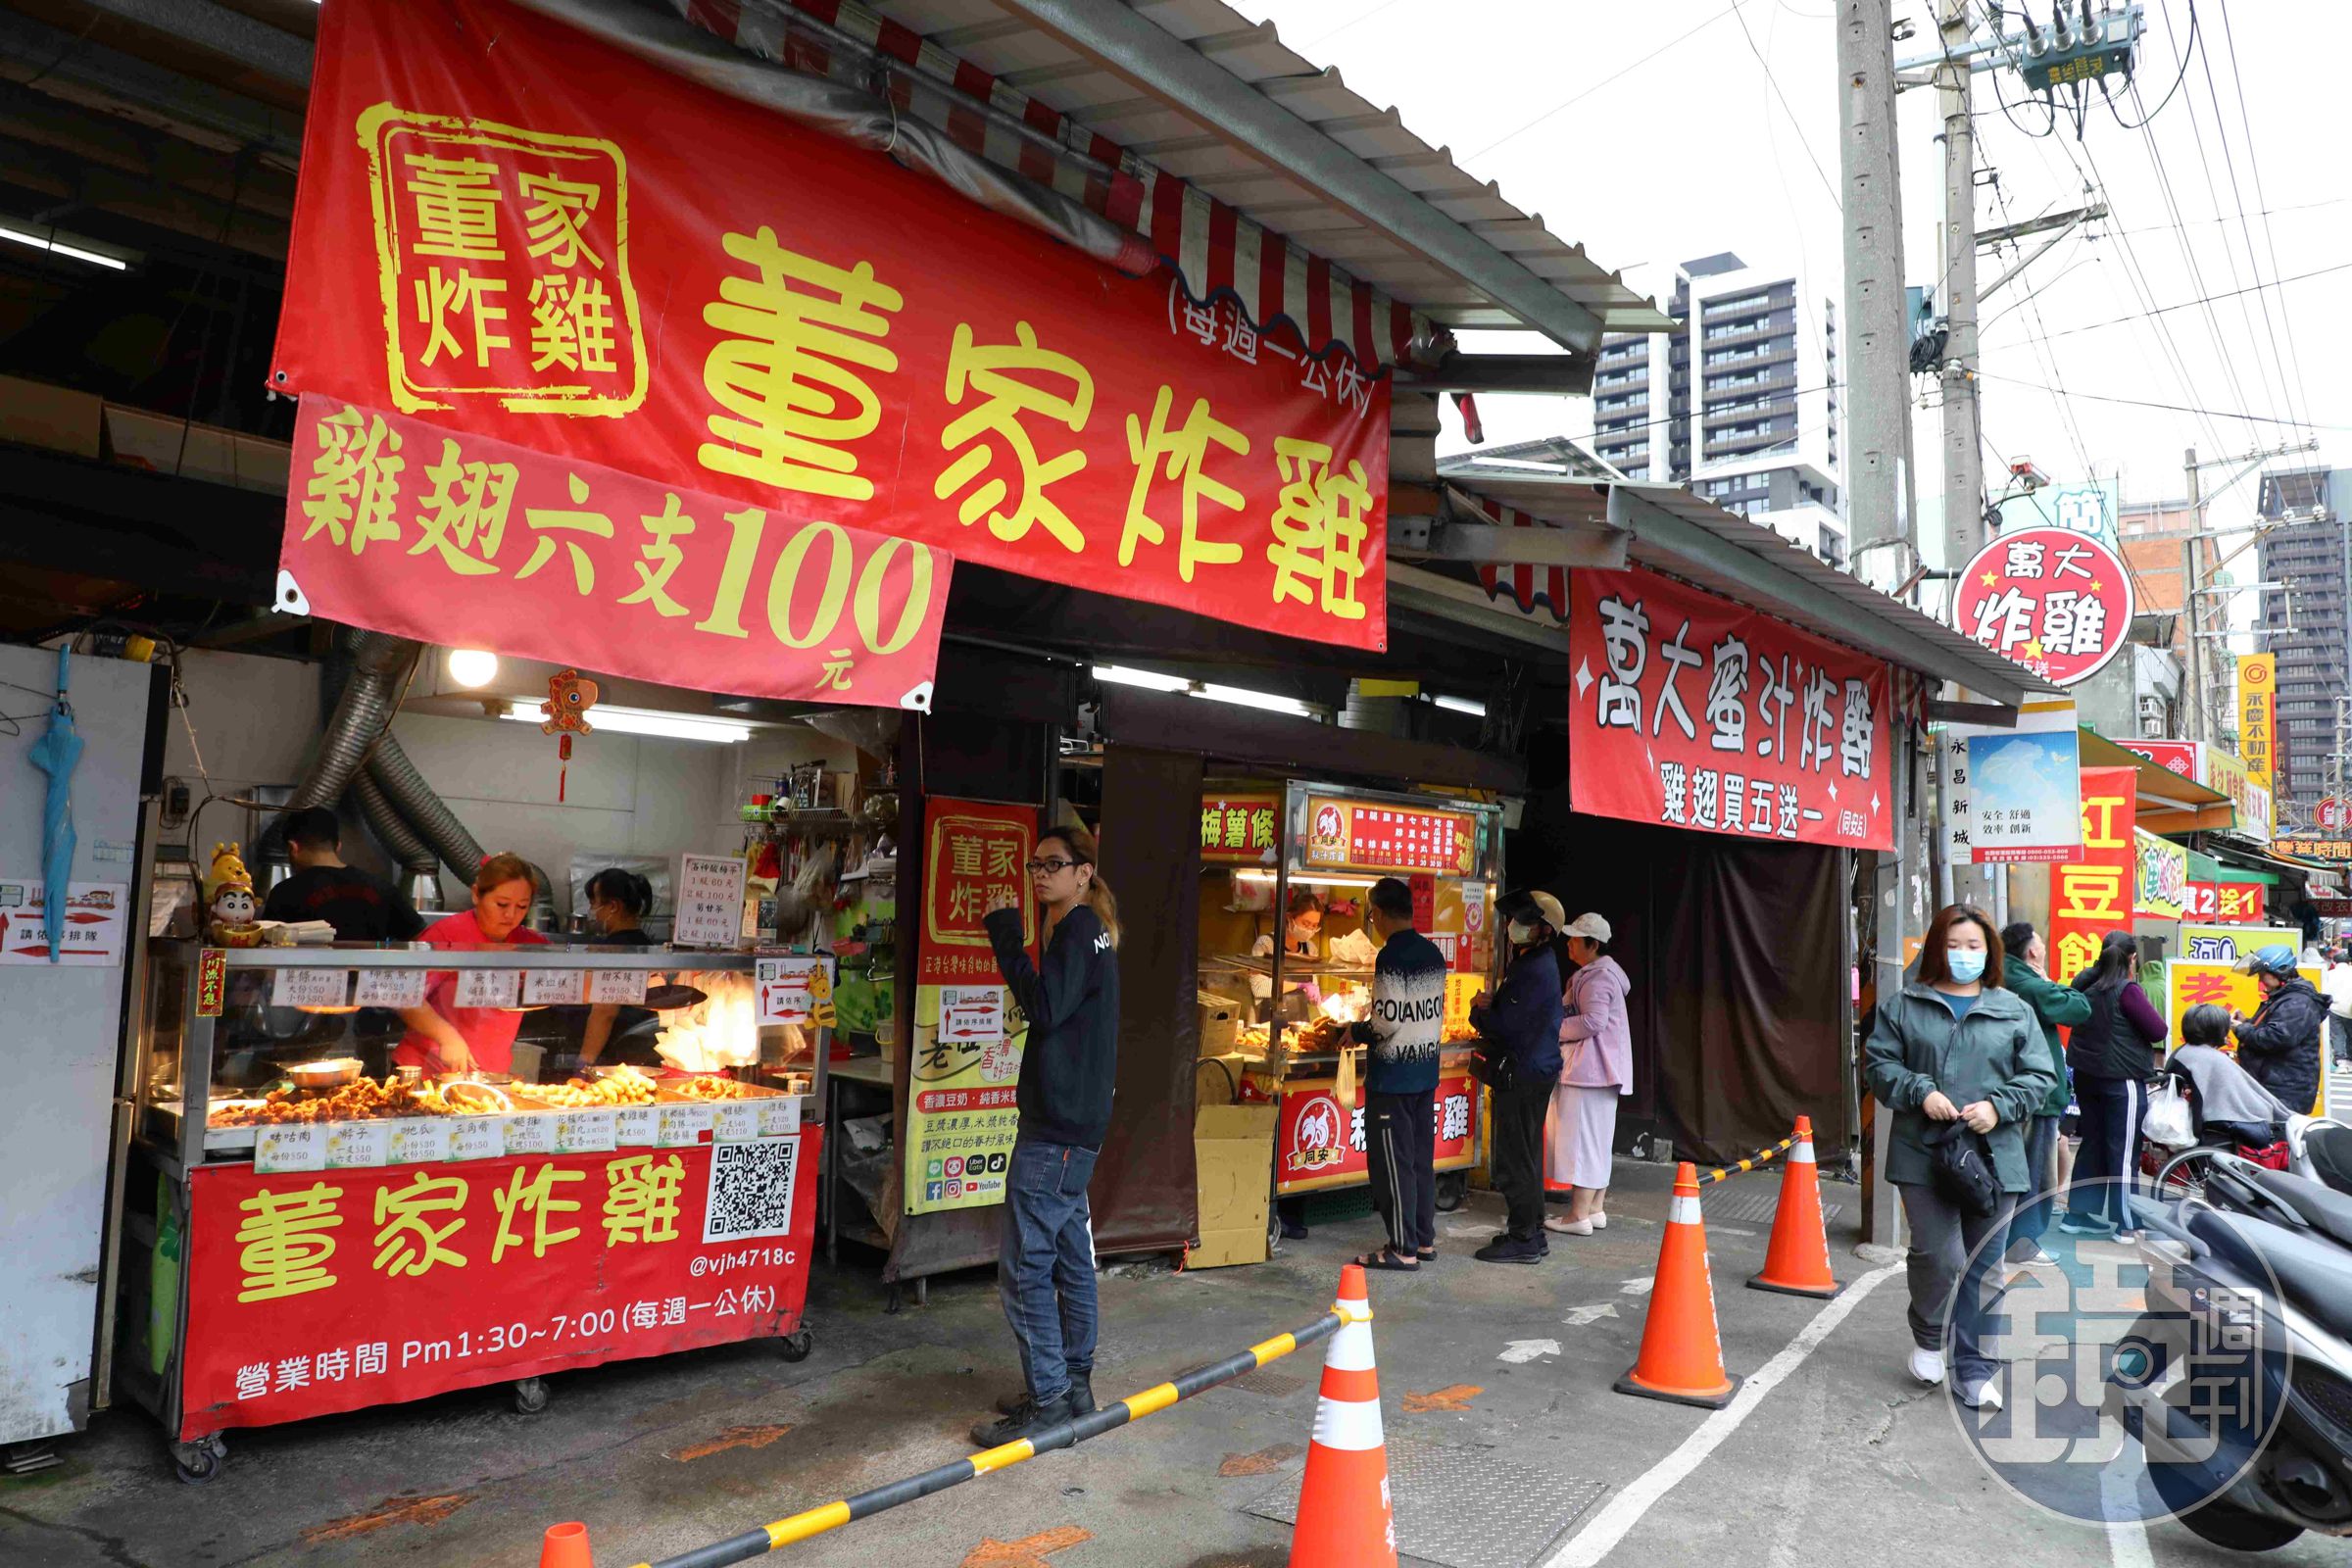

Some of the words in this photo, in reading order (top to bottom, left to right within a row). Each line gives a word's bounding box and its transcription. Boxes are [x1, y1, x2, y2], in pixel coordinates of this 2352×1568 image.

[403, 154, 604, 270] 董家
[414, 267, 617, 373] 炸雞
[697, 225, 1374, 621] 董家炸雞
[2003, 540, 2095, 579] 萬大
[1972, 585, 2107, 656] 炸雞
[1597, 592, 1874, 779] 萬大蜜汁炸雞
[2245, 692, 2266, 772] 永慶不動產
[1659, 761, 1824, 839] 雞翅買五送一
[1950, 738, 1971, 846] 永昌新城
[1982, 809, 2004, 821] 安全
[2009, 808, 2032, 820] 舒適
[1983, 823, 2004, 835] 效率
[2010, 823, 2032, 834] 創新
[951, 835, 1018, 877] 董家
[20, 928, 98, 941] 請依排隊
[979, 1179, 1002, 1191] YouTube
[1304, 1149, 1329, 1164] 同安
[235, 1154, 686, 1303] 董家炸雞
[690, 1247, 796, 1278] @vjh4718c
[235, 1341, 388, 1401] 營業時間
[401, 1310, 615, 1369] Pm1:30~7:00
[621, 1285, 775, 1334] (每週一公休)
